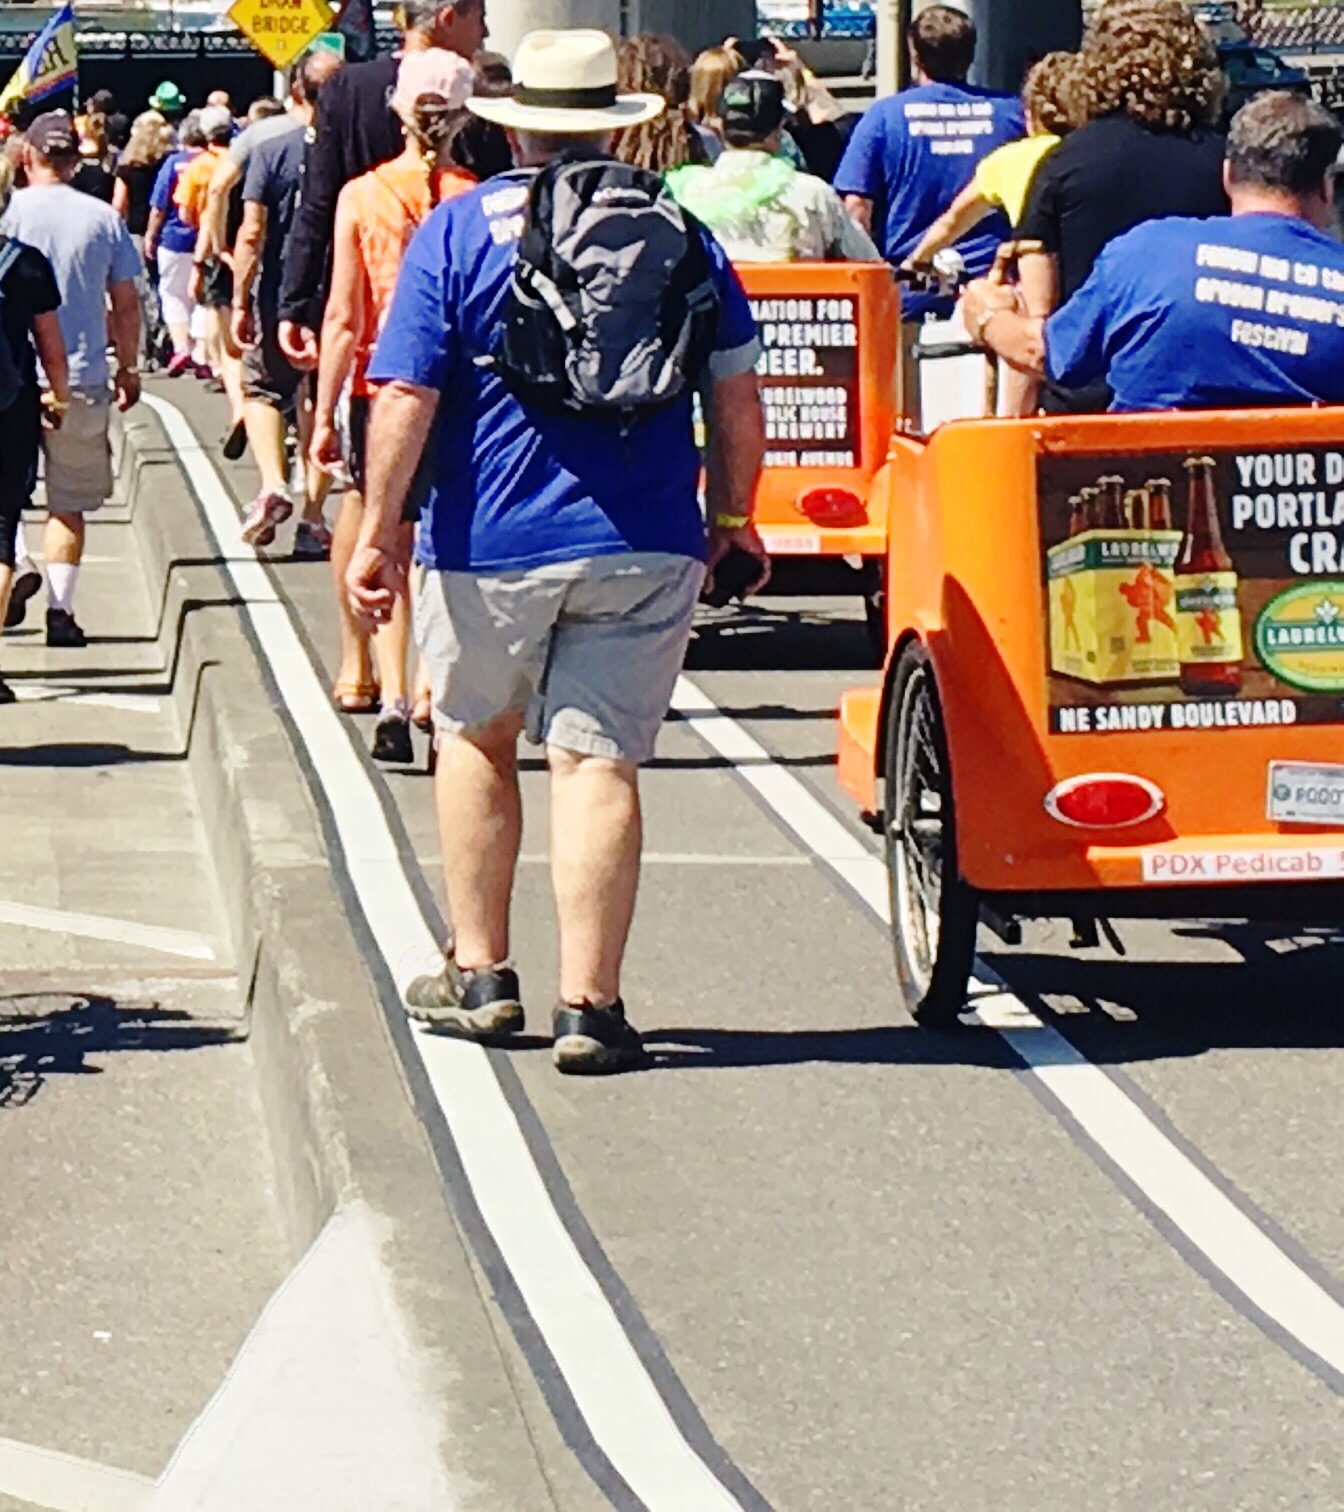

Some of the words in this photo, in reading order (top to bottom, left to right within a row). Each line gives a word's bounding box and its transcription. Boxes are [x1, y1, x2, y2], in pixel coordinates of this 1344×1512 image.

[252, 14, 310, 34] BRIDGE
[816, 299, 854, 321] FOR
[763, 323, 858, 346] PREMIER
[1236, 453, 1317, 488] YOUR
[1325, 451, 1344, 485] D
[1289, 531, 1344, 575] CR
[1060, 704, 1090, 732] NE
[1095, 702, 1166, 731] SANDY
[1170, 699, 1297, 727] BOULEVARD
[1151, 854, 1206, 875] PDX
[1215, 851, 1323, 875] Pedicab
